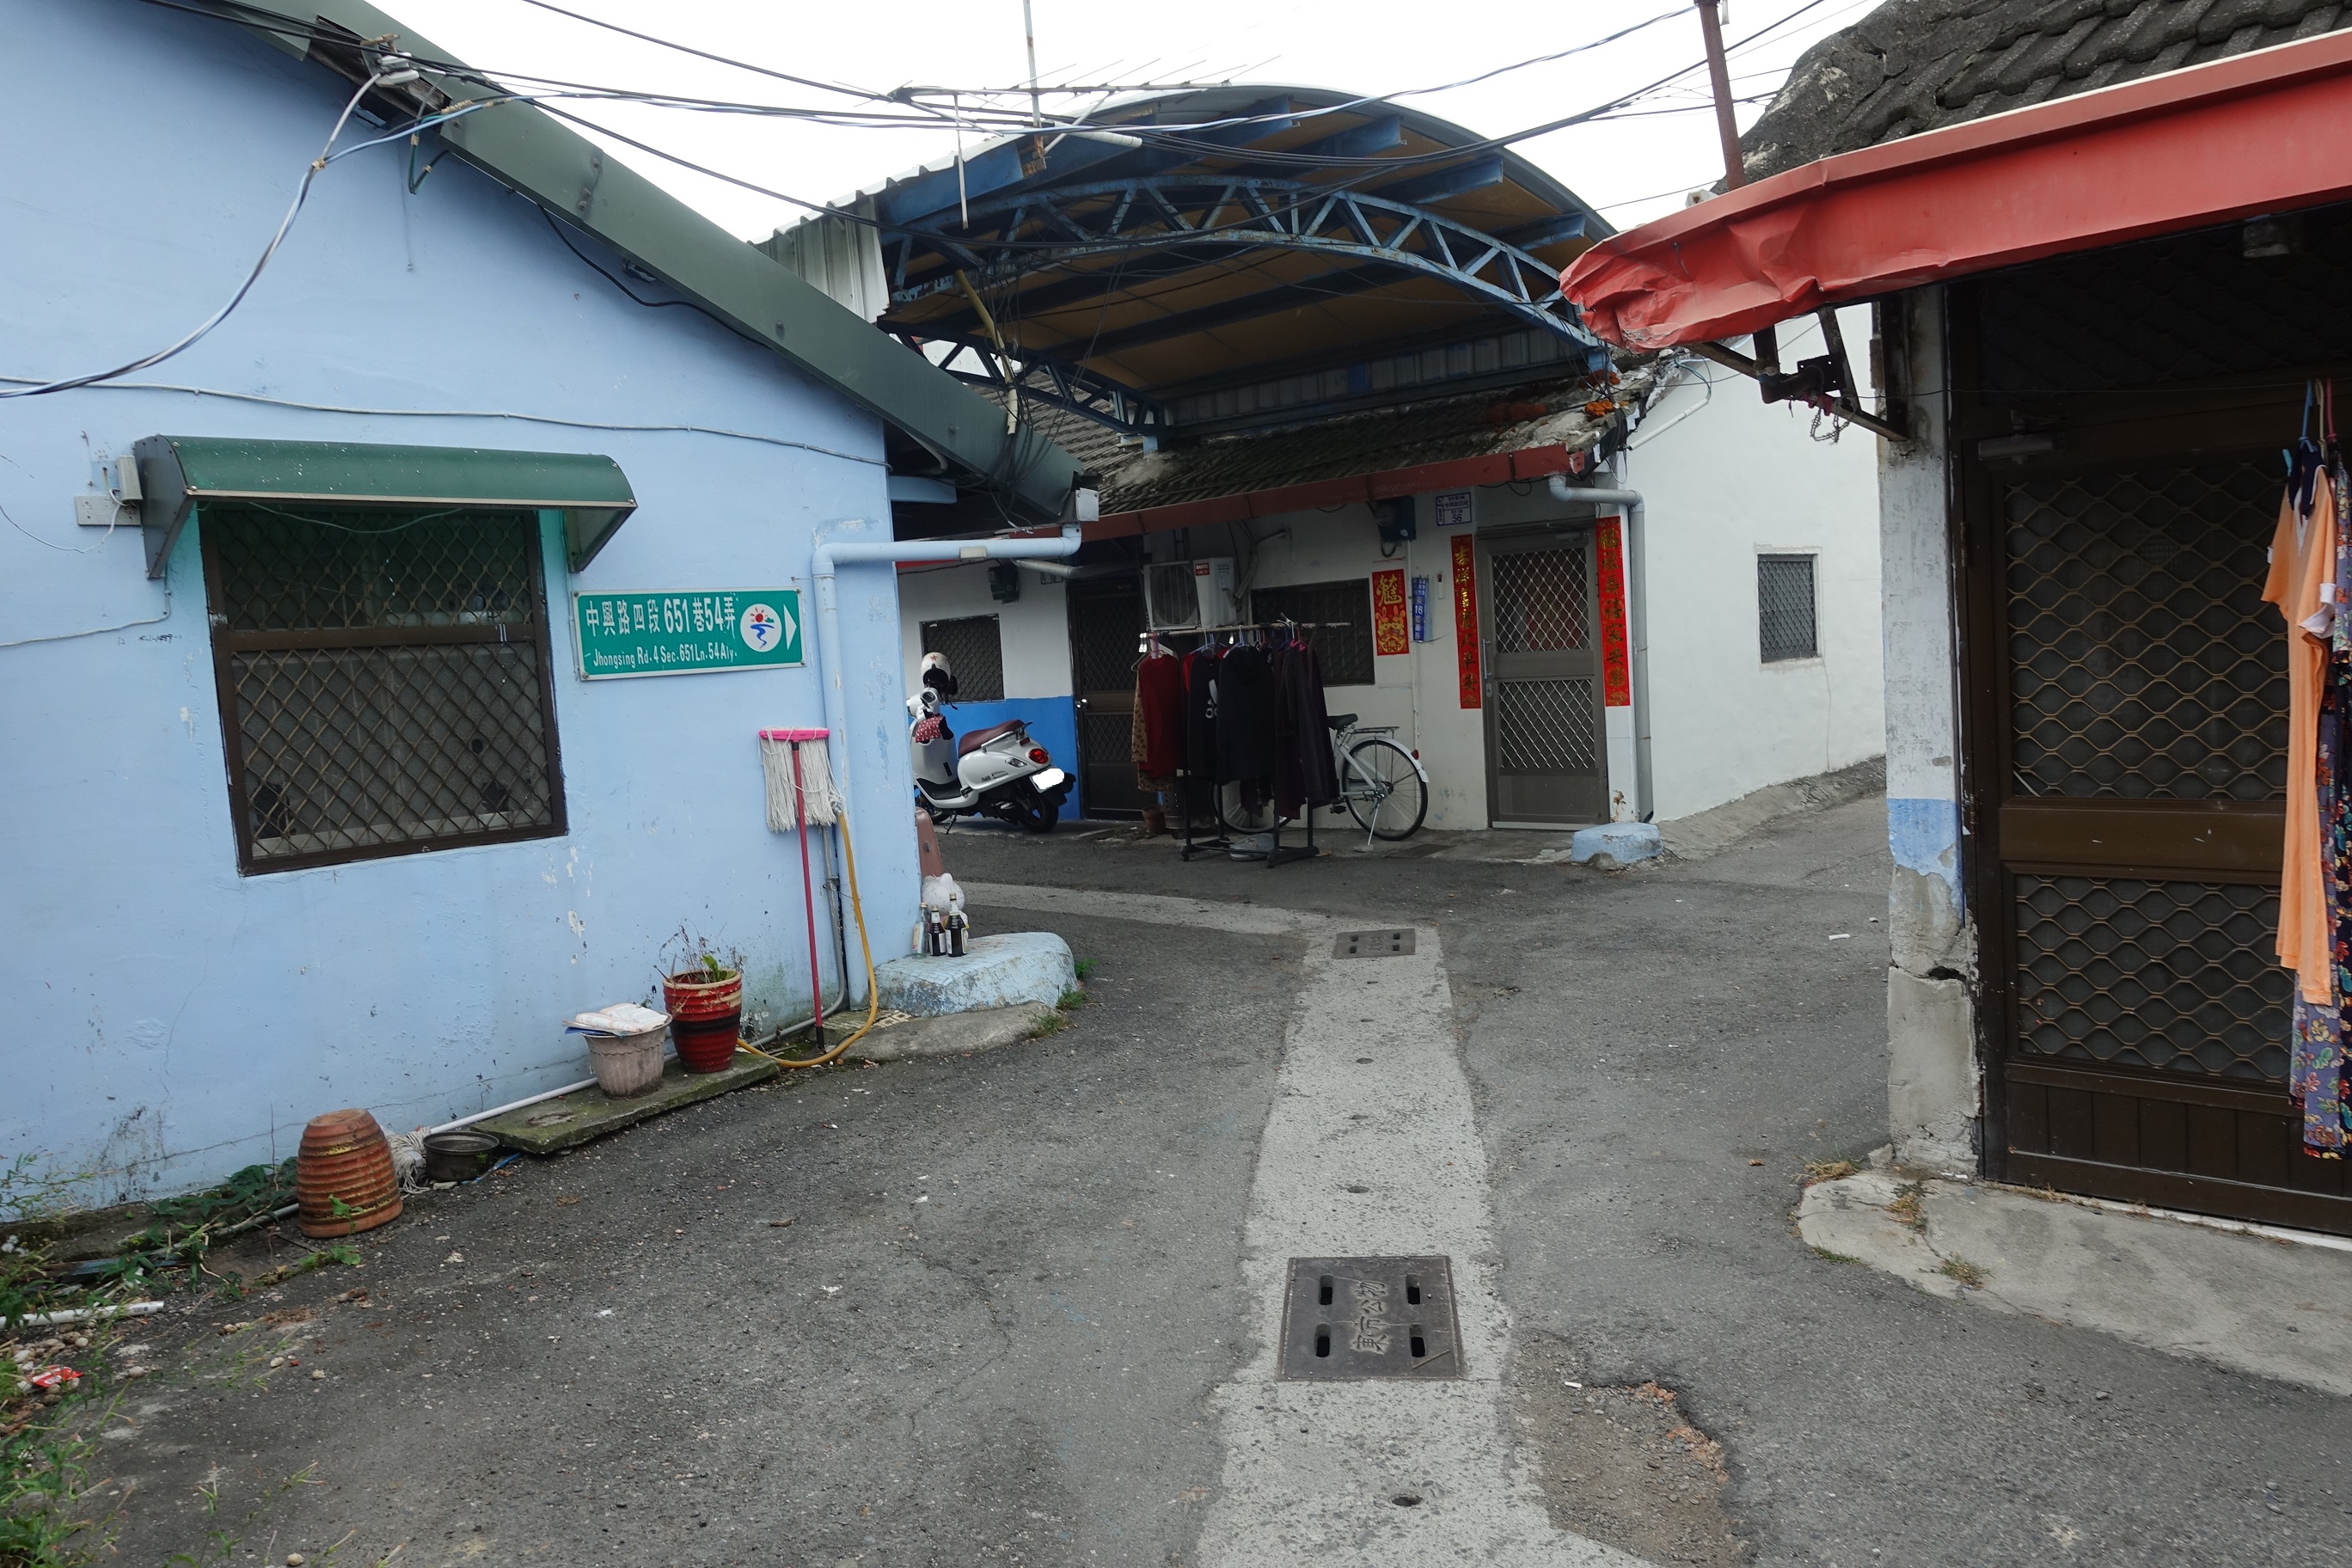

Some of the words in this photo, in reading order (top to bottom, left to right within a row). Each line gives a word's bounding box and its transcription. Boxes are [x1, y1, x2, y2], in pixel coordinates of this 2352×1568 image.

[1453, 513, 1461, 523] 56
[593, 648, 635, 670] Jhongsing
[652, 646, 659, 664] 4
[1353, 1281, 1387, 1352] 東市公物
